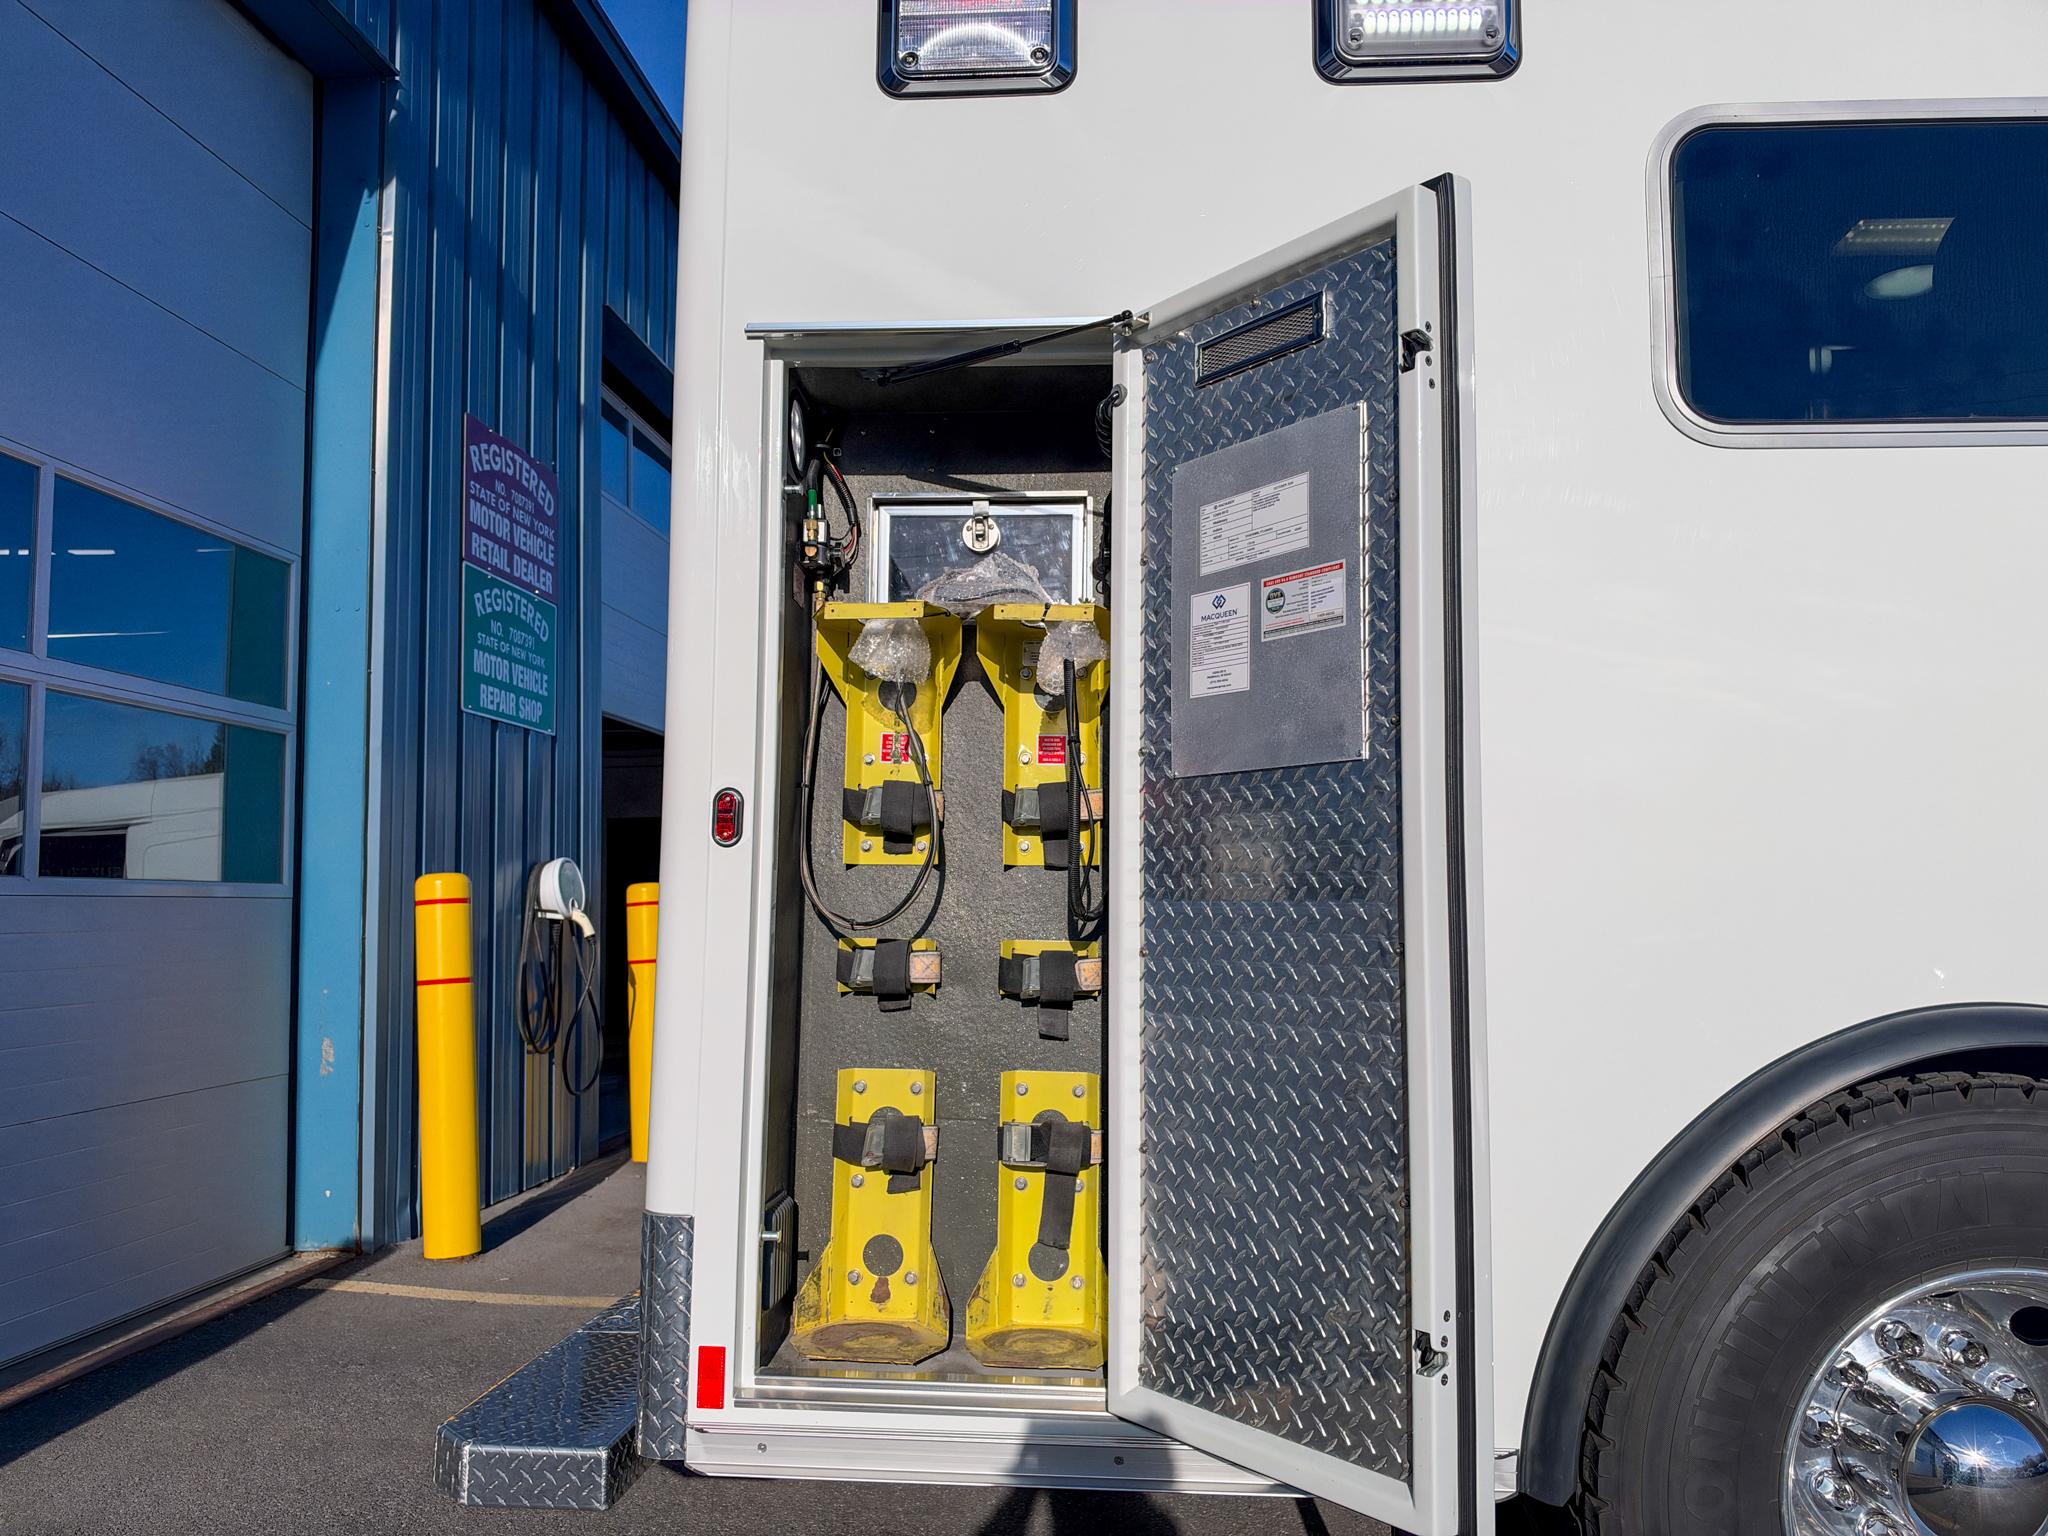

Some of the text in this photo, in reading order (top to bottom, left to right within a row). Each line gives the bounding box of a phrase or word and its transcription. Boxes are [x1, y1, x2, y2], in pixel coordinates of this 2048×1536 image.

[469, 443, 554, 517] REGISTERED
[469, 498, 555, 567] MOTOR VEHICLE
[470, 480, 555, 542] STATE OF NEW YORK
[471, 532, 553, 594] RETAIL DEALER
[473, 587, 549, 642] REGISTERED
[491, 619, 504, 637] NO.
[1200, 609, 1238, 622] MACQUEEN
[473, 648, 548, 697] MOTOR VEHICLE
[477, 632, 545, 669] STATE OF NEW YORK
[480, 683, 543, 724] REPAIR SHOP
